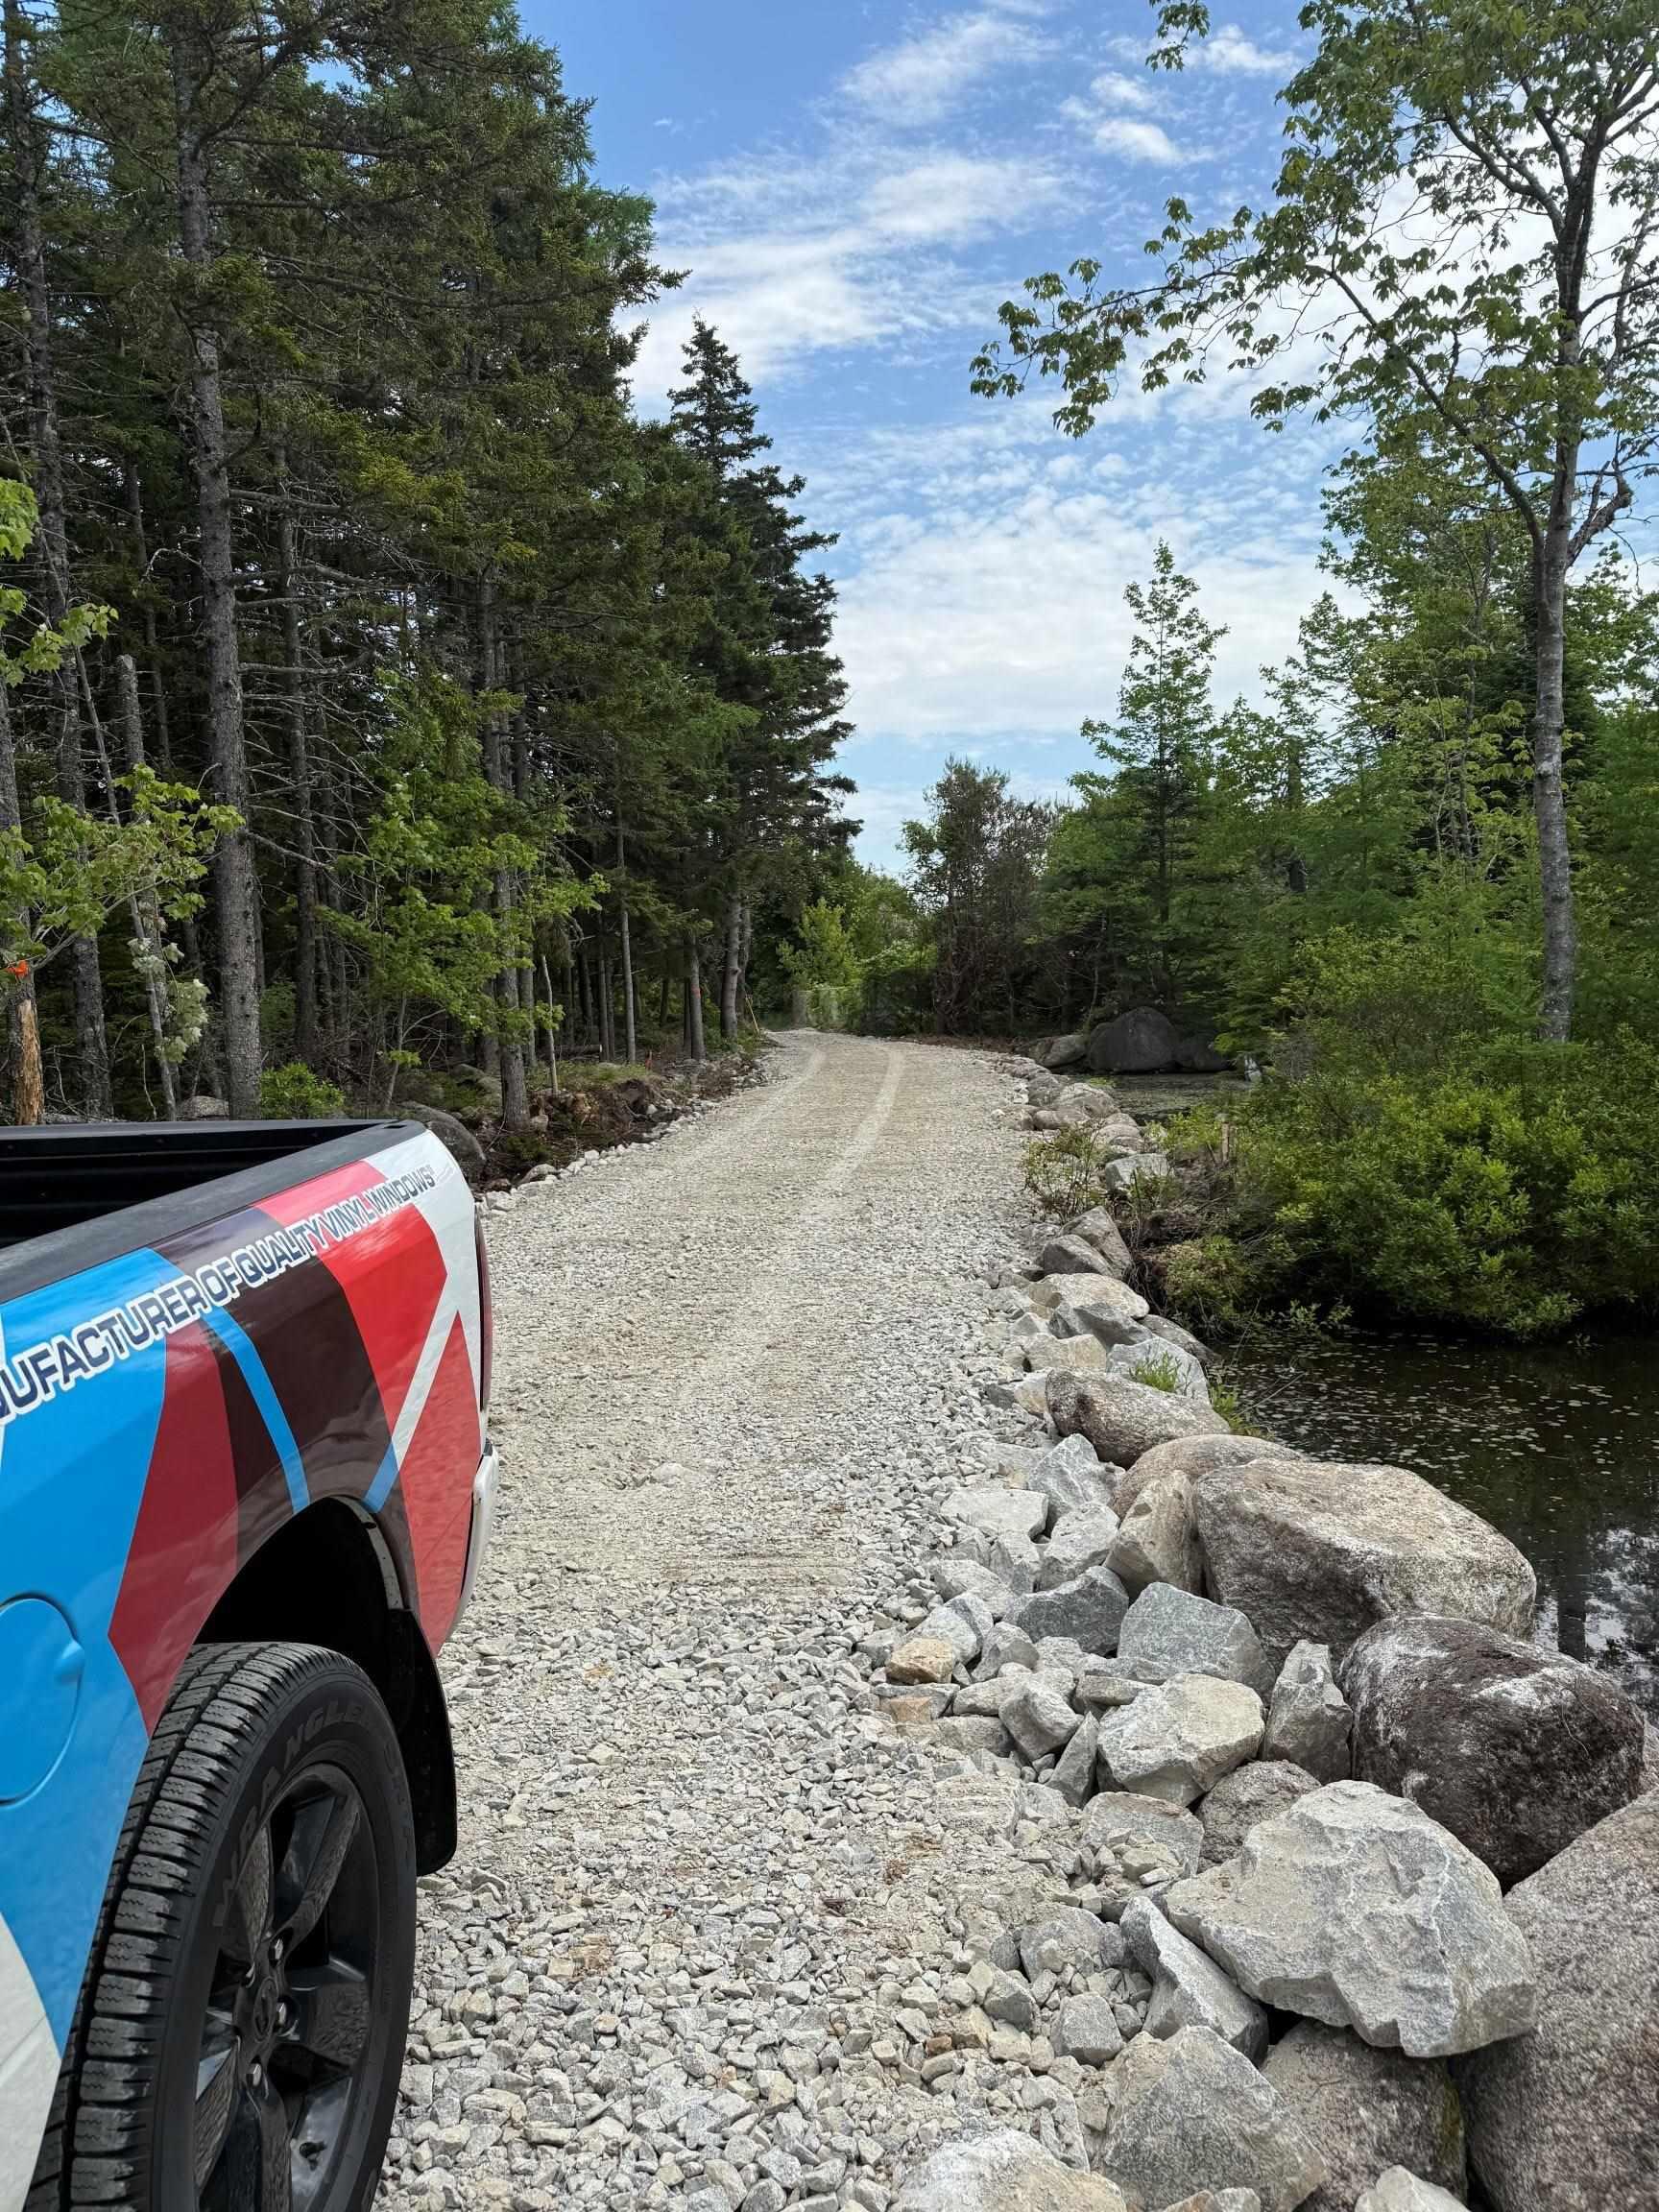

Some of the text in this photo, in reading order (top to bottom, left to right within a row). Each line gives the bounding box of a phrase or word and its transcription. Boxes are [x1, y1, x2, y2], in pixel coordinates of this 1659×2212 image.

[198, 1260, 238, 1304] OF
[233, 1217, 327, 1286] QUALITY
[321, 1197, 376, 1239] VINYL
